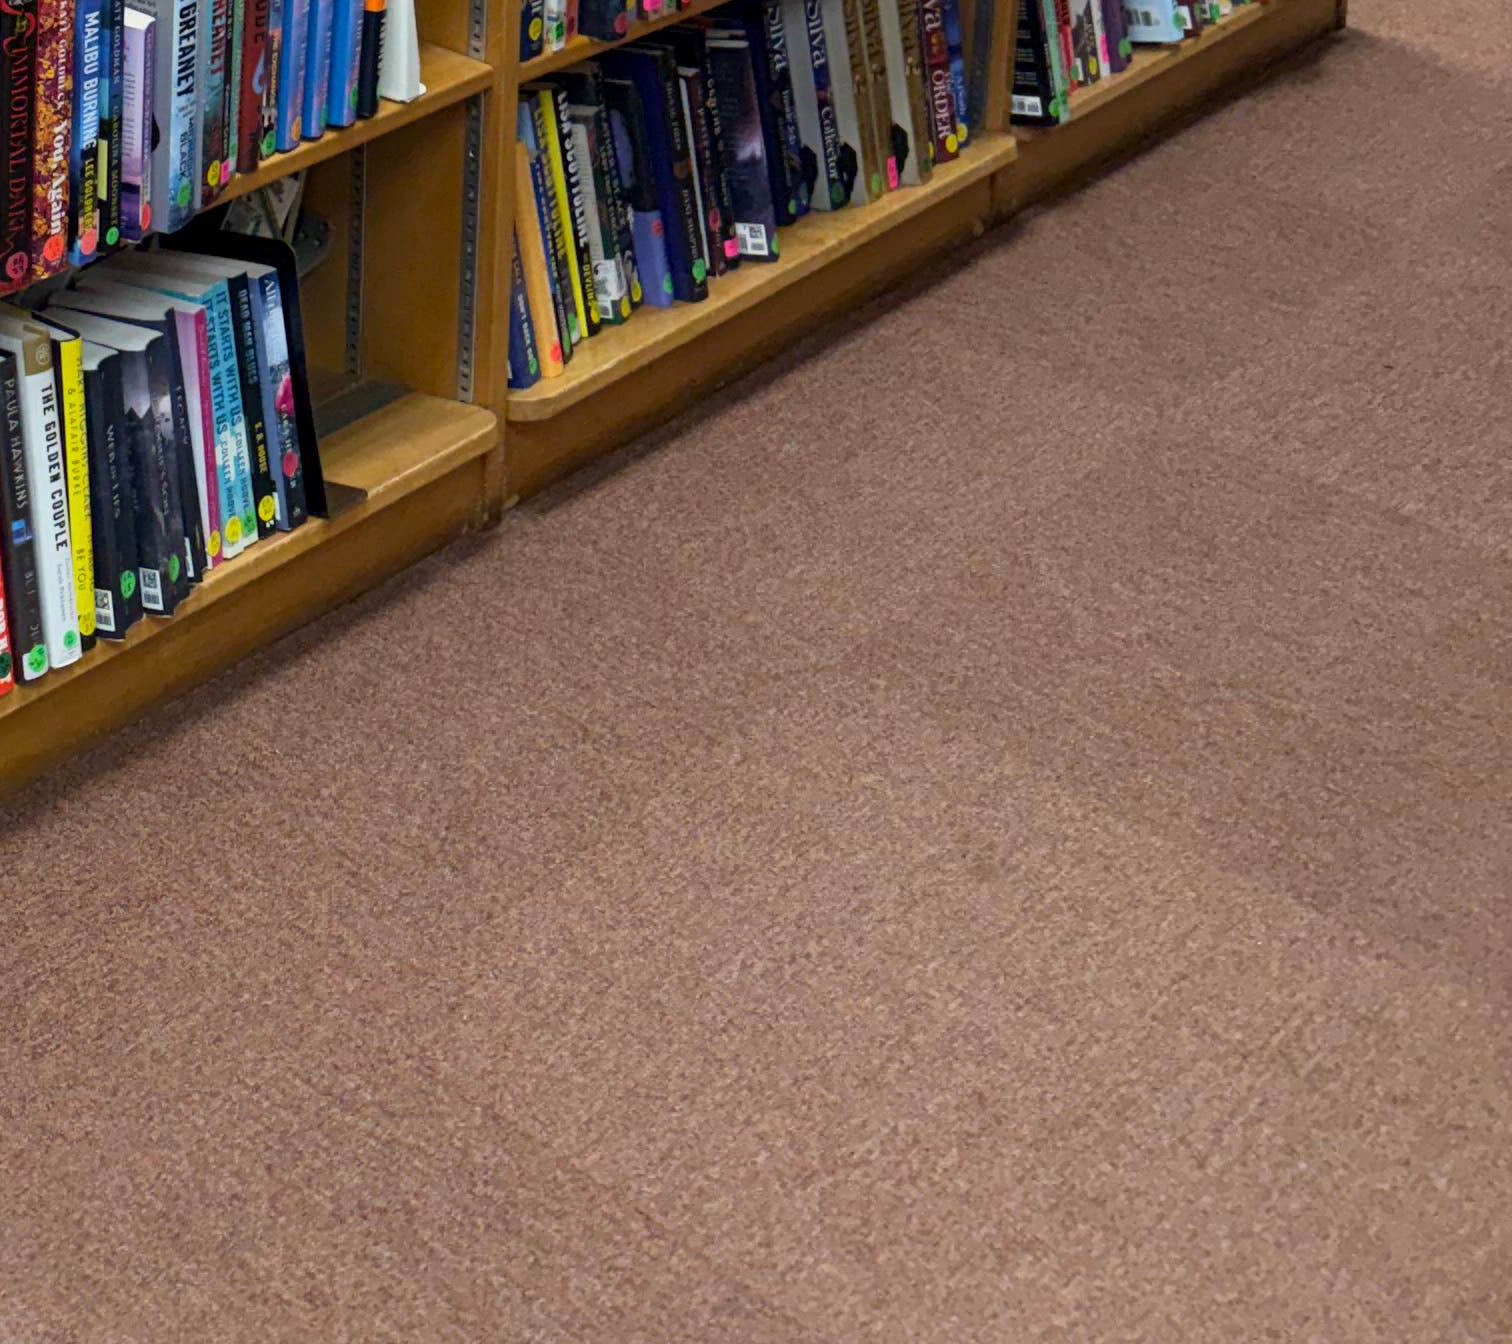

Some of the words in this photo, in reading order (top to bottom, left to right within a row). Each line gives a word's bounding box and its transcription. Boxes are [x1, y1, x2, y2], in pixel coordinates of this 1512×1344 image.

[931, 69, 952, 139] ORDER
[41, 383, 54, 416] THE
[44, 421, 61, 484] GOLDEN
[51, 488, 68, 551] COUPLE
